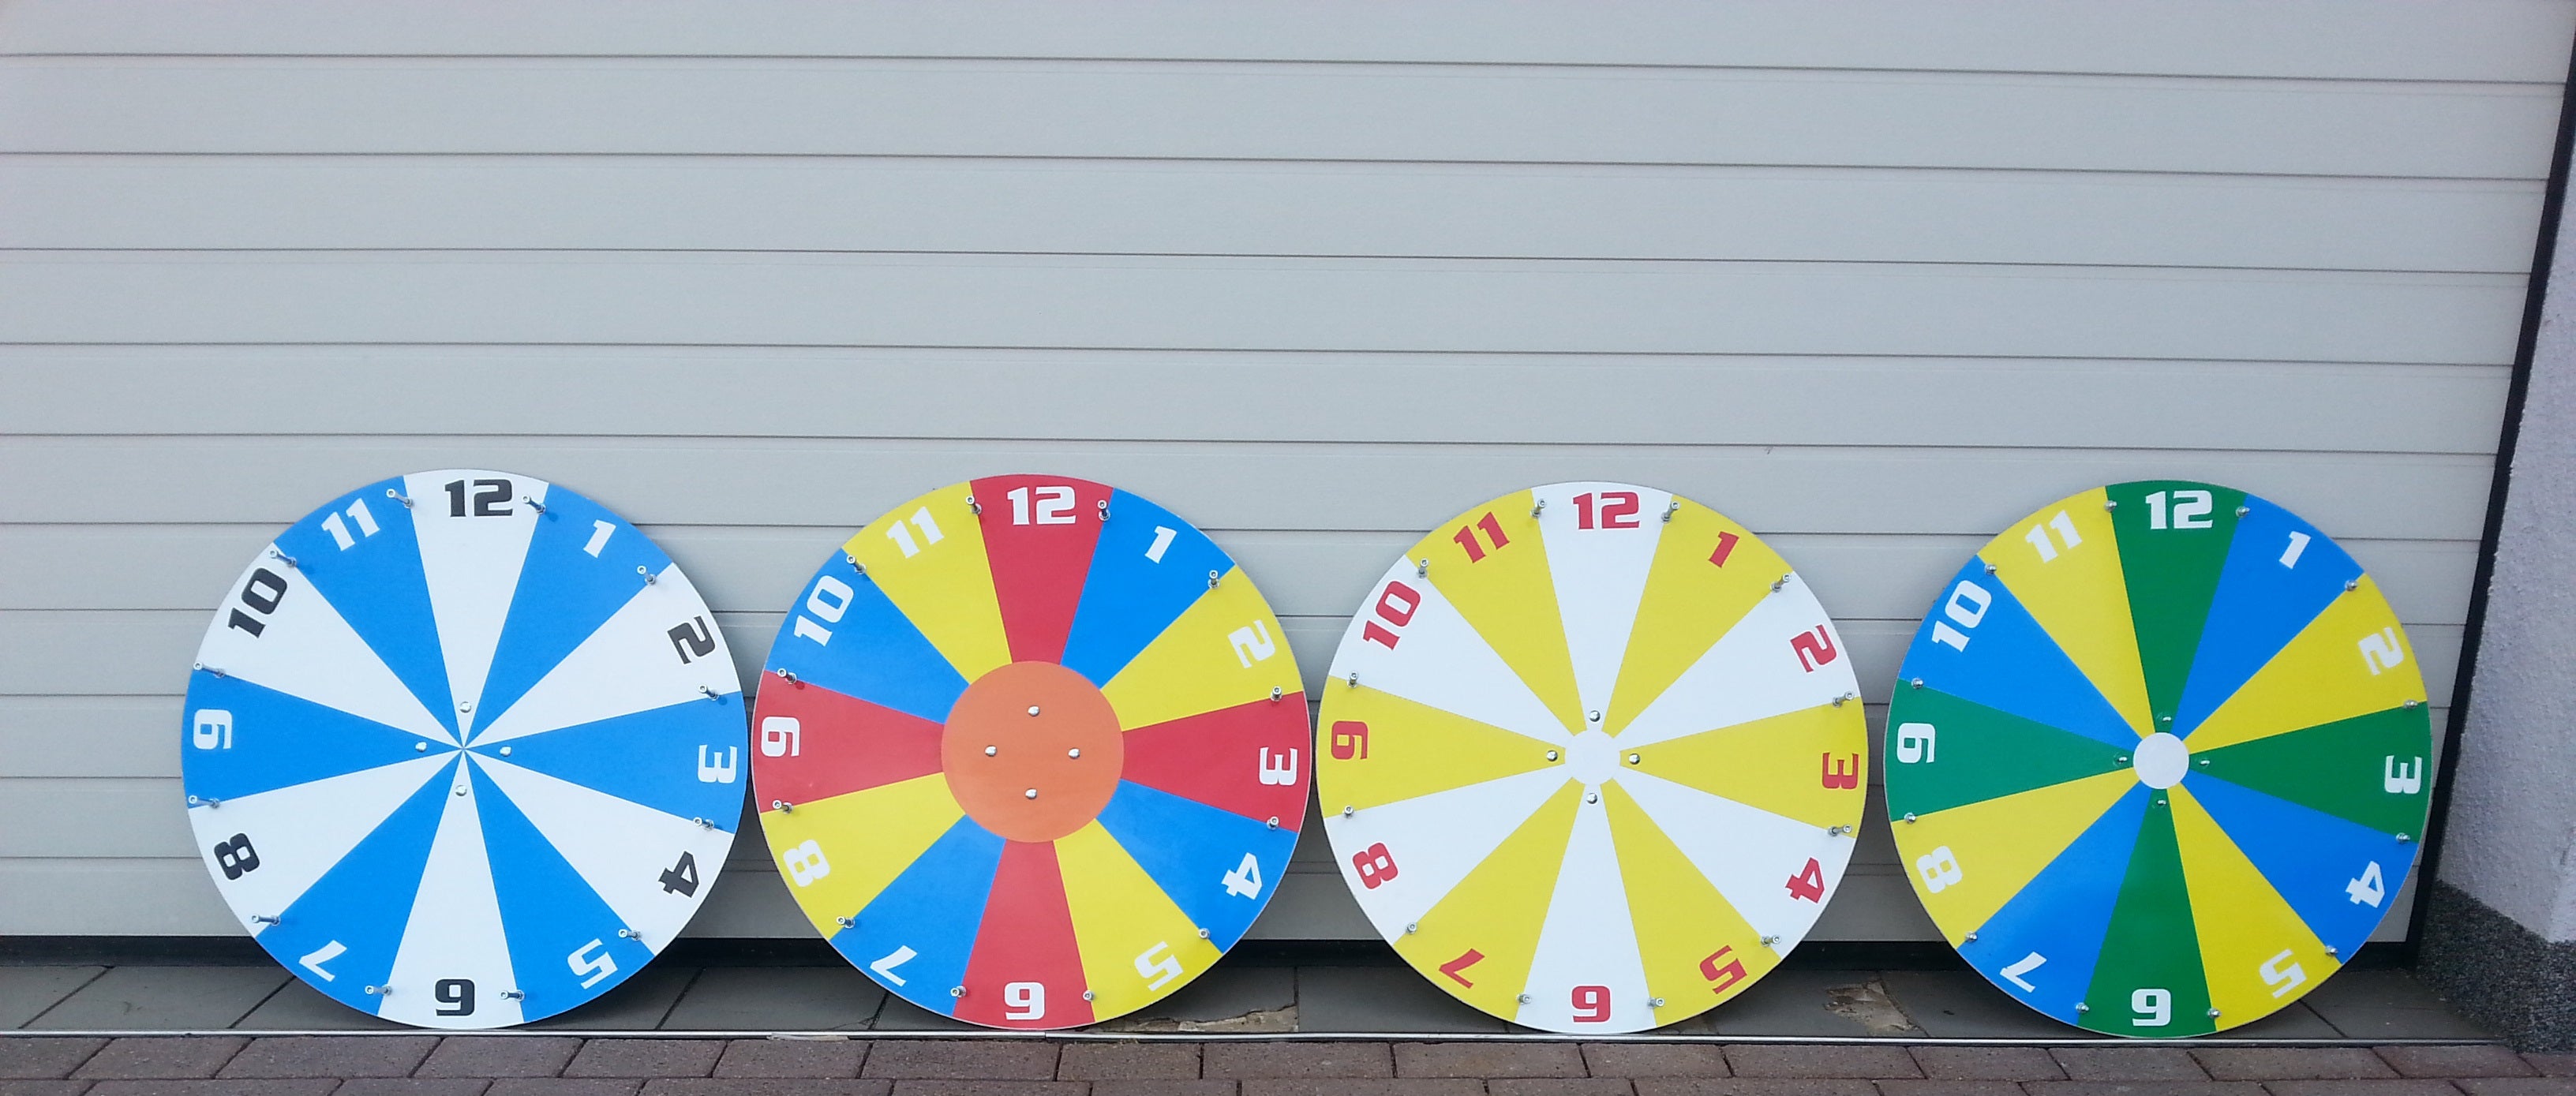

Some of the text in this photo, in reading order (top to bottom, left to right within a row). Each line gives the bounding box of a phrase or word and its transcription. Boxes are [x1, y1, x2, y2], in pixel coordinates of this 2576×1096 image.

[444, 479, 514, 518] 12
[1006, 486, 1076, 526] 12
[1572, 491, 1640, 530] 12
[2145, 490, 2214, 530] 12
[321, 497, 380, 552] 11
[582, 519, 616, 559] 1
[886, 507, 945, 559] 11
[1144, 526, 1178, 564] 1
[1453, 511, 1511, 563] 11
[2024, 509, 2083, 563] 11
[1708, 530, 1739, 568] 1
[2278, 530, 2312, 570] 1
[227, 567, 288, 638] 10
[793, 574, 854, 646] 10
[1362, 580, 1421, 651] 10
[1931, 580, 1992, 653] 10
[667, 615, 716, 664] 2
[1227, 619, 1275, 668] 2
[1789, 625, 1837, 673] 2
[2357, 627, 2404, 676] 2
[193, 709, 233, 750] 9
[760, 716, 801, 757] 9
[1331, 720, 1368, 760] 9
[1896, 722, 1936, 764] 9
[697, 744, 738, 784] 3
[1258, 746, 1298, 787] 3
[1821, 751, 1859, 790] 3
[2383, 754, 2423, 795] 3
[213, 832, 260, 881] 8
[657, 850, 700, 899] 4
[782, 839, 830, 888] 8
[1221, 852, 1263, 900] 4
[1352, 842, 1399, 889] 8
[1915, 845, 1963, 894] 8
[1784, 857, 1825, 904] 4
[2345, 860, 2386, 908] 4
[298, 939, 348, 982] 7
[567, 937, 618, 990] 5
[870, 945, 918, 987] 7
[1134, 941, 1184, 991] 5
[1438, 948, 1485, 989] 7
[1698, 945, 1747, 994] 5
[1999, 951, 2047, 993] 7
[2258, 948, 2308, 998] 5
[435, 978, 476, 1017] 6
[1003, 982, 1045, 1020] 6
[1571, 985, 1611, 1023] 6
[2131, 989, 2172, 1027] 6
